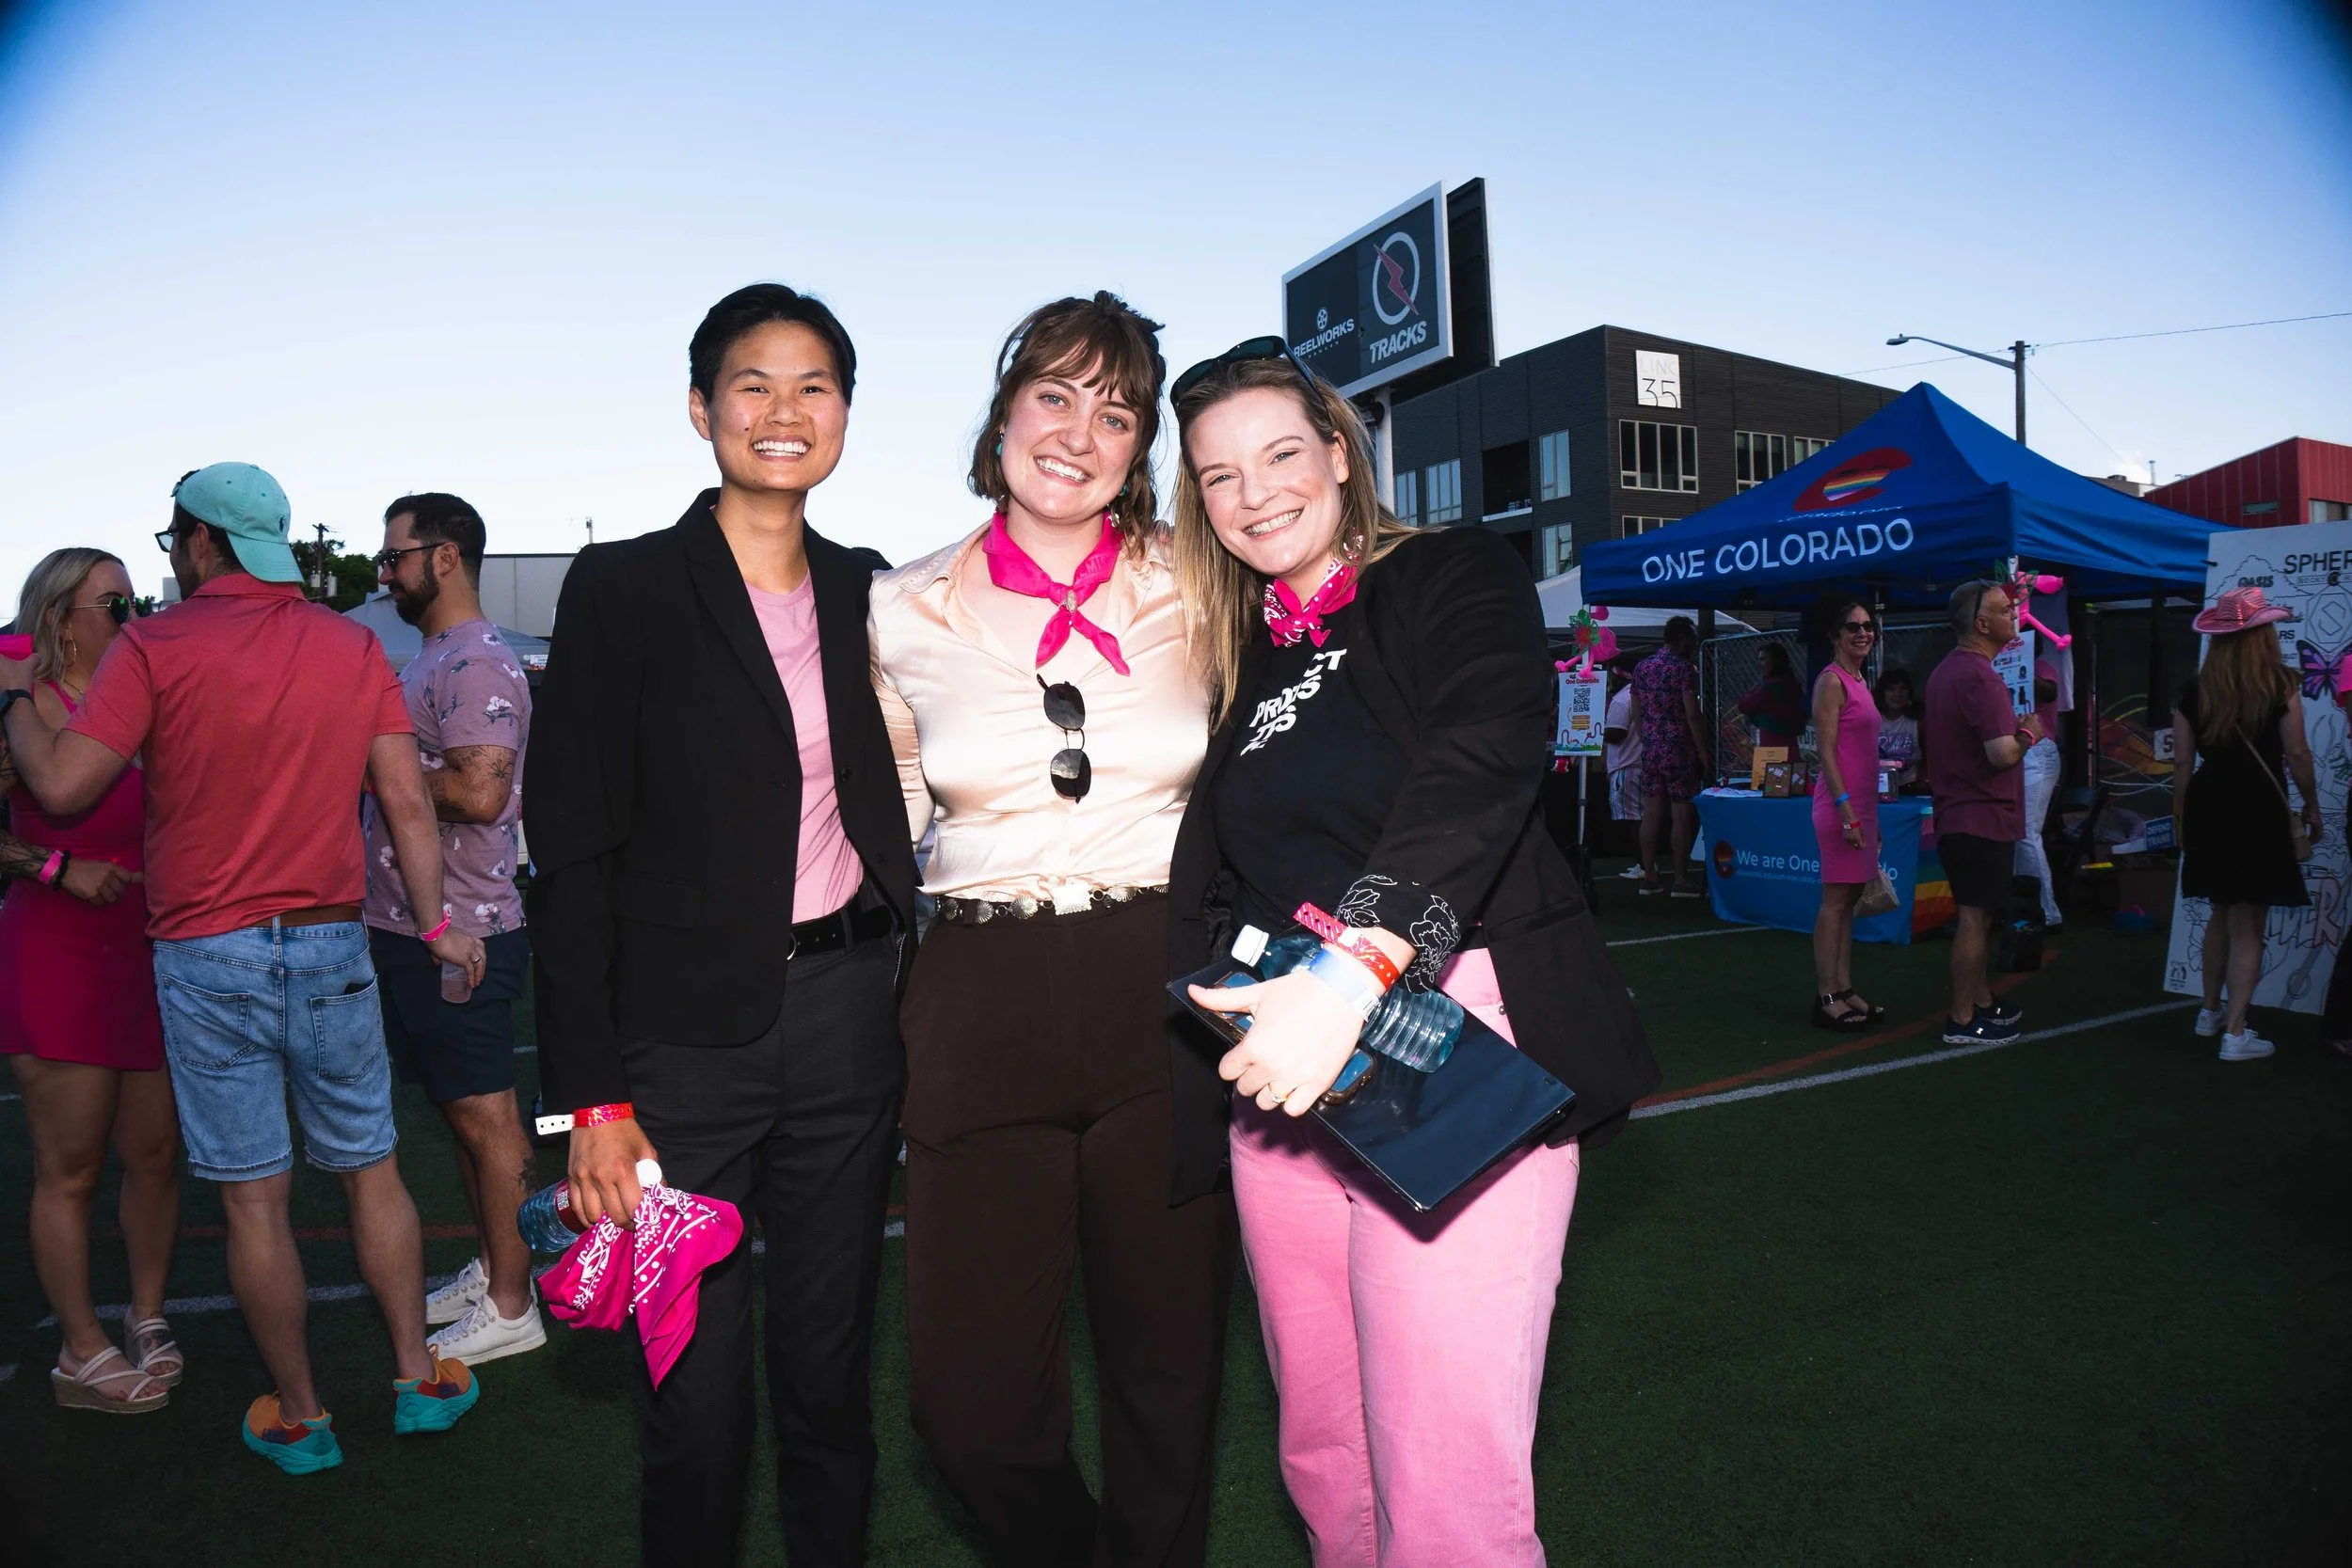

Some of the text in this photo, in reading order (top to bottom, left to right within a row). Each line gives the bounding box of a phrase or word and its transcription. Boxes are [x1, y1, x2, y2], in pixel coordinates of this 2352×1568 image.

[1294, 318, 1355, 357] REELWORKS
[1370, 321, 1427, 364] TRACKS
[1642, 377, 1678, 408] 35
[1641, 517, 1915, 583] ONE COLORADO
[1736, 849, 1820, 873] We are One
